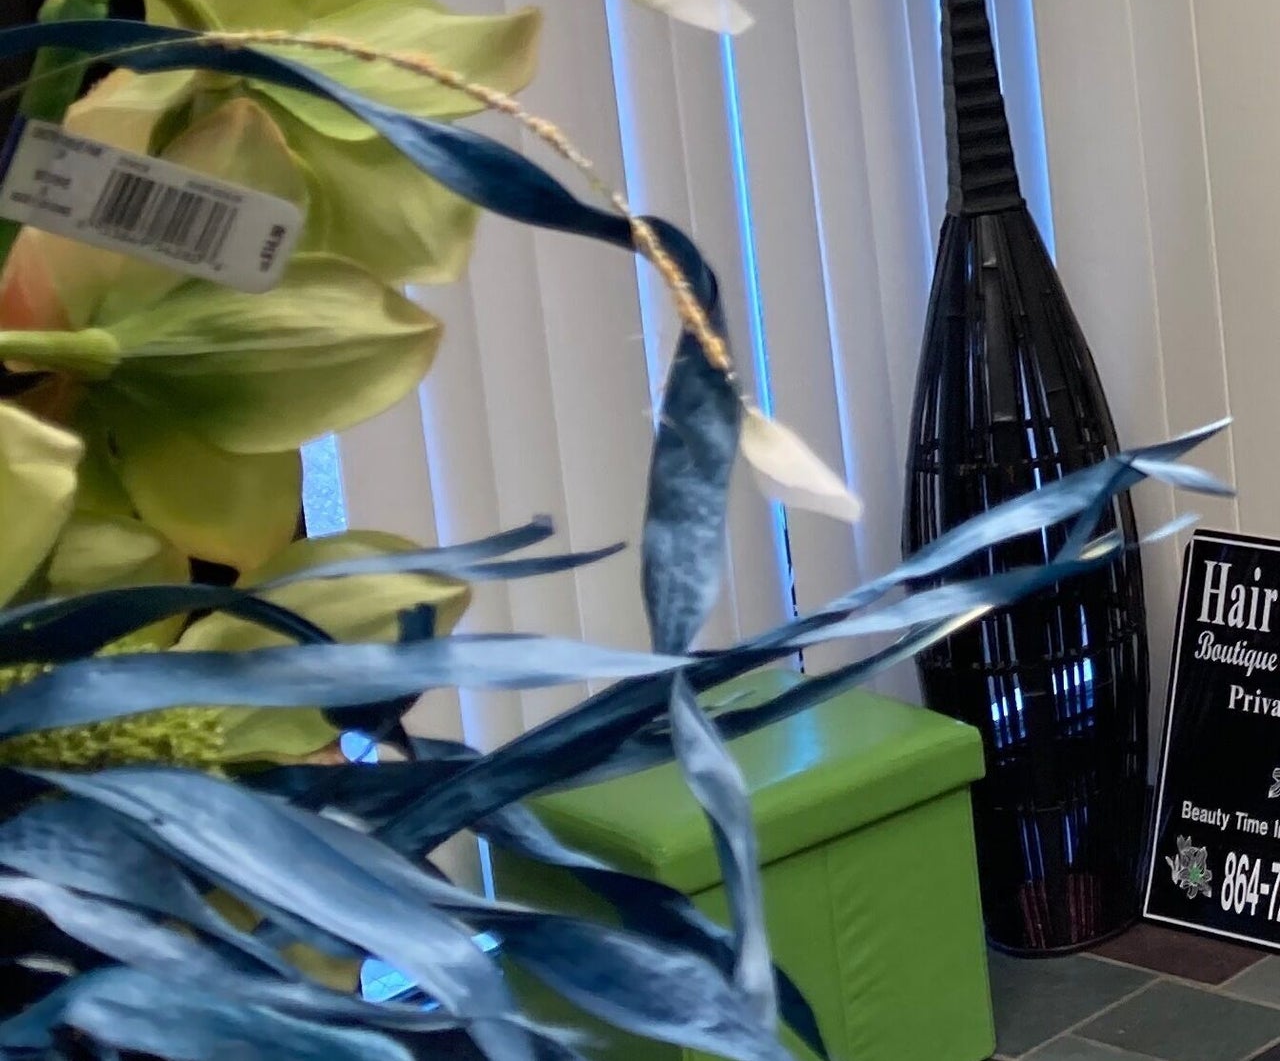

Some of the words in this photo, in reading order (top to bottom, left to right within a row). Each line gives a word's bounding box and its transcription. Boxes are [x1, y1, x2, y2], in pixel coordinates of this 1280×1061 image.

[1196, 559, 1279, 633] Hair
[1194, 630, 1279, 677] Boutique
[1181, 800, 1231, 831] Beauty
[1235, 811, 1269, 836] Time
